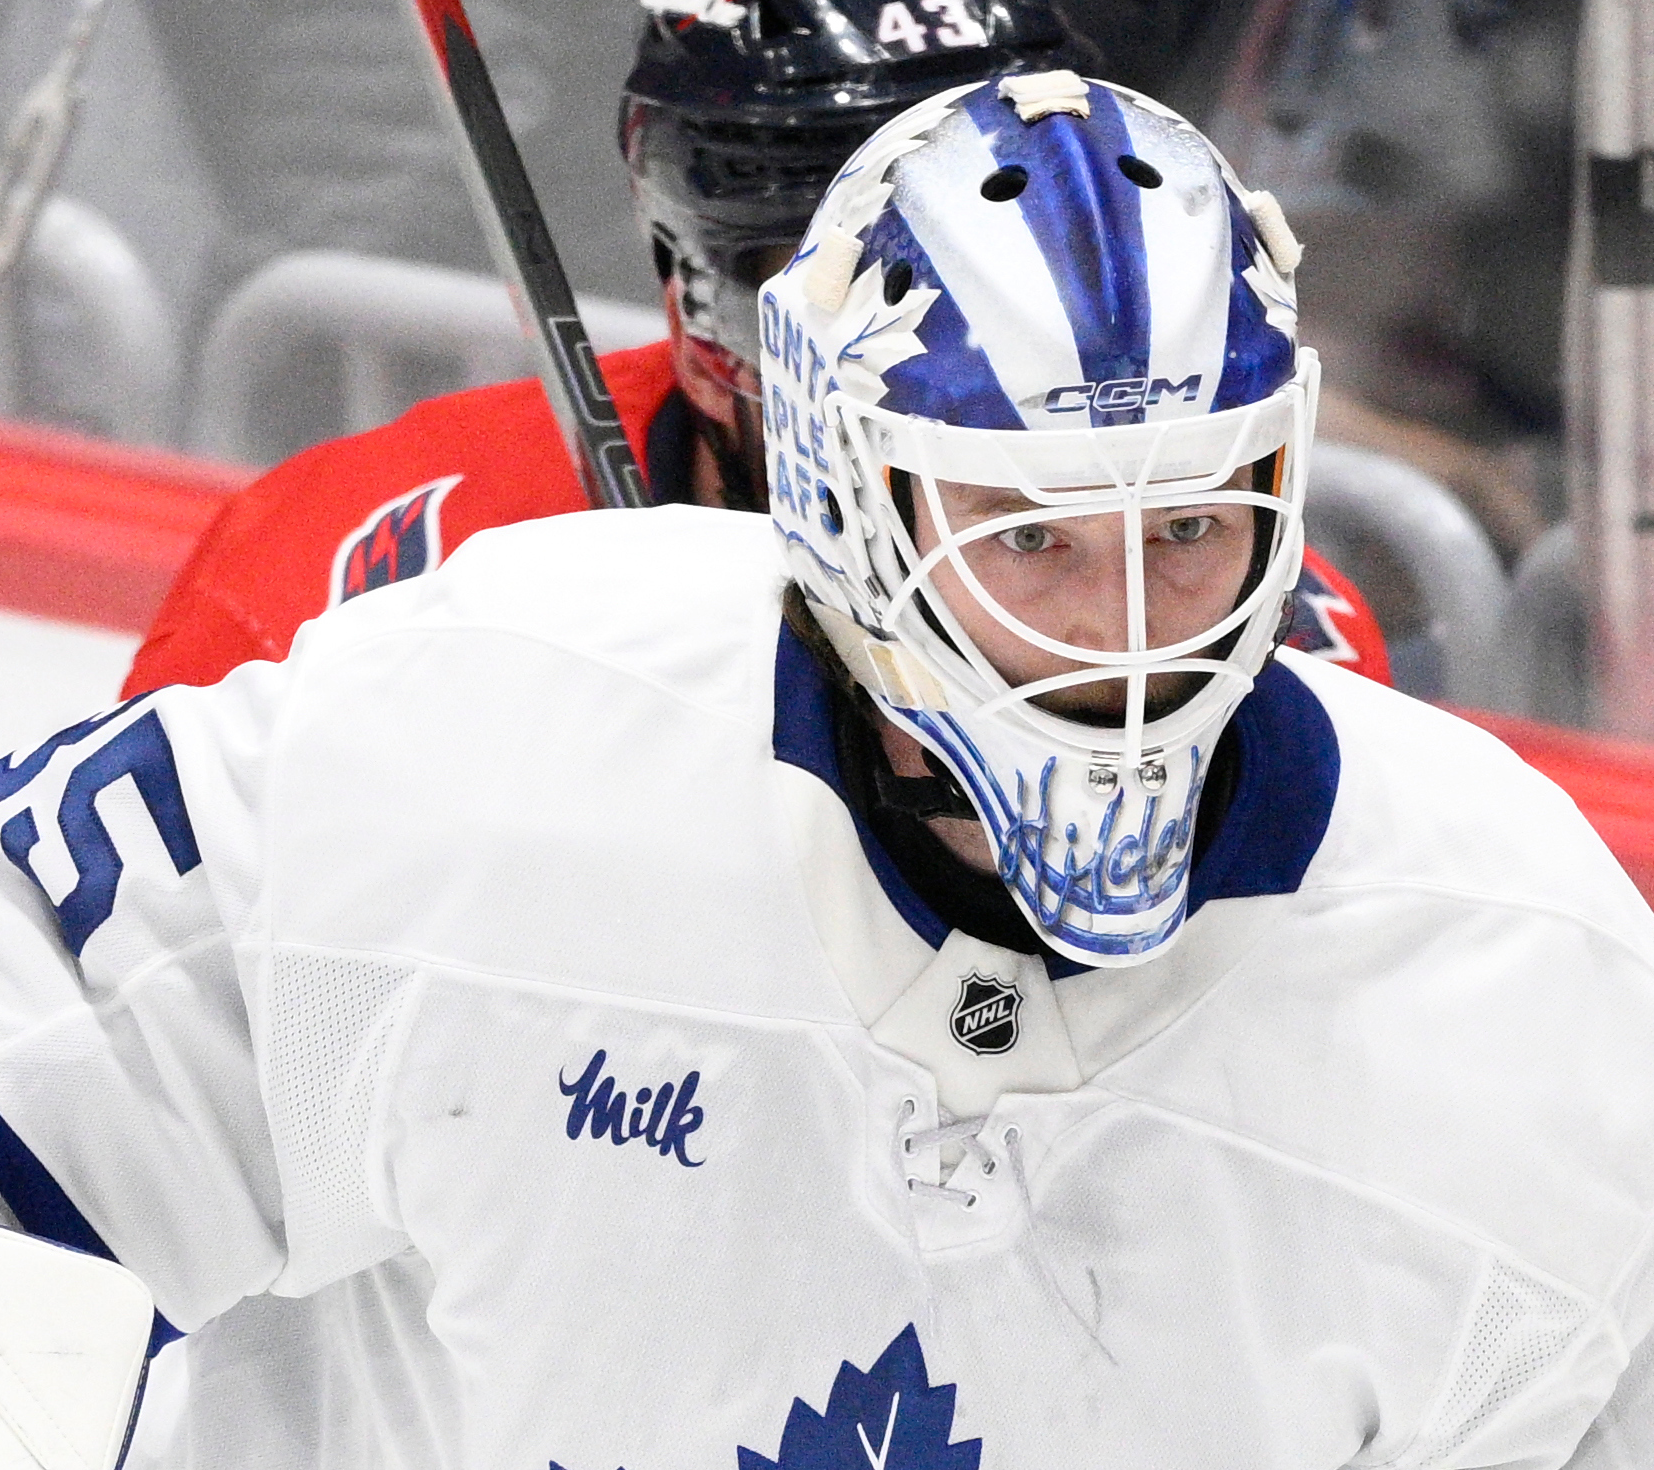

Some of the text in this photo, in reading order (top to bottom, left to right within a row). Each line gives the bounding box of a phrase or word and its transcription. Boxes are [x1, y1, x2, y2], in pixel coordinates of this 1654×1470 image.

[877, 0, 989, 54] 43
[1044, 373, 1204, 415] CCM
[962, 1000, 1010, 1034] NHL
[559, 1049, 707, 1167] Milk
